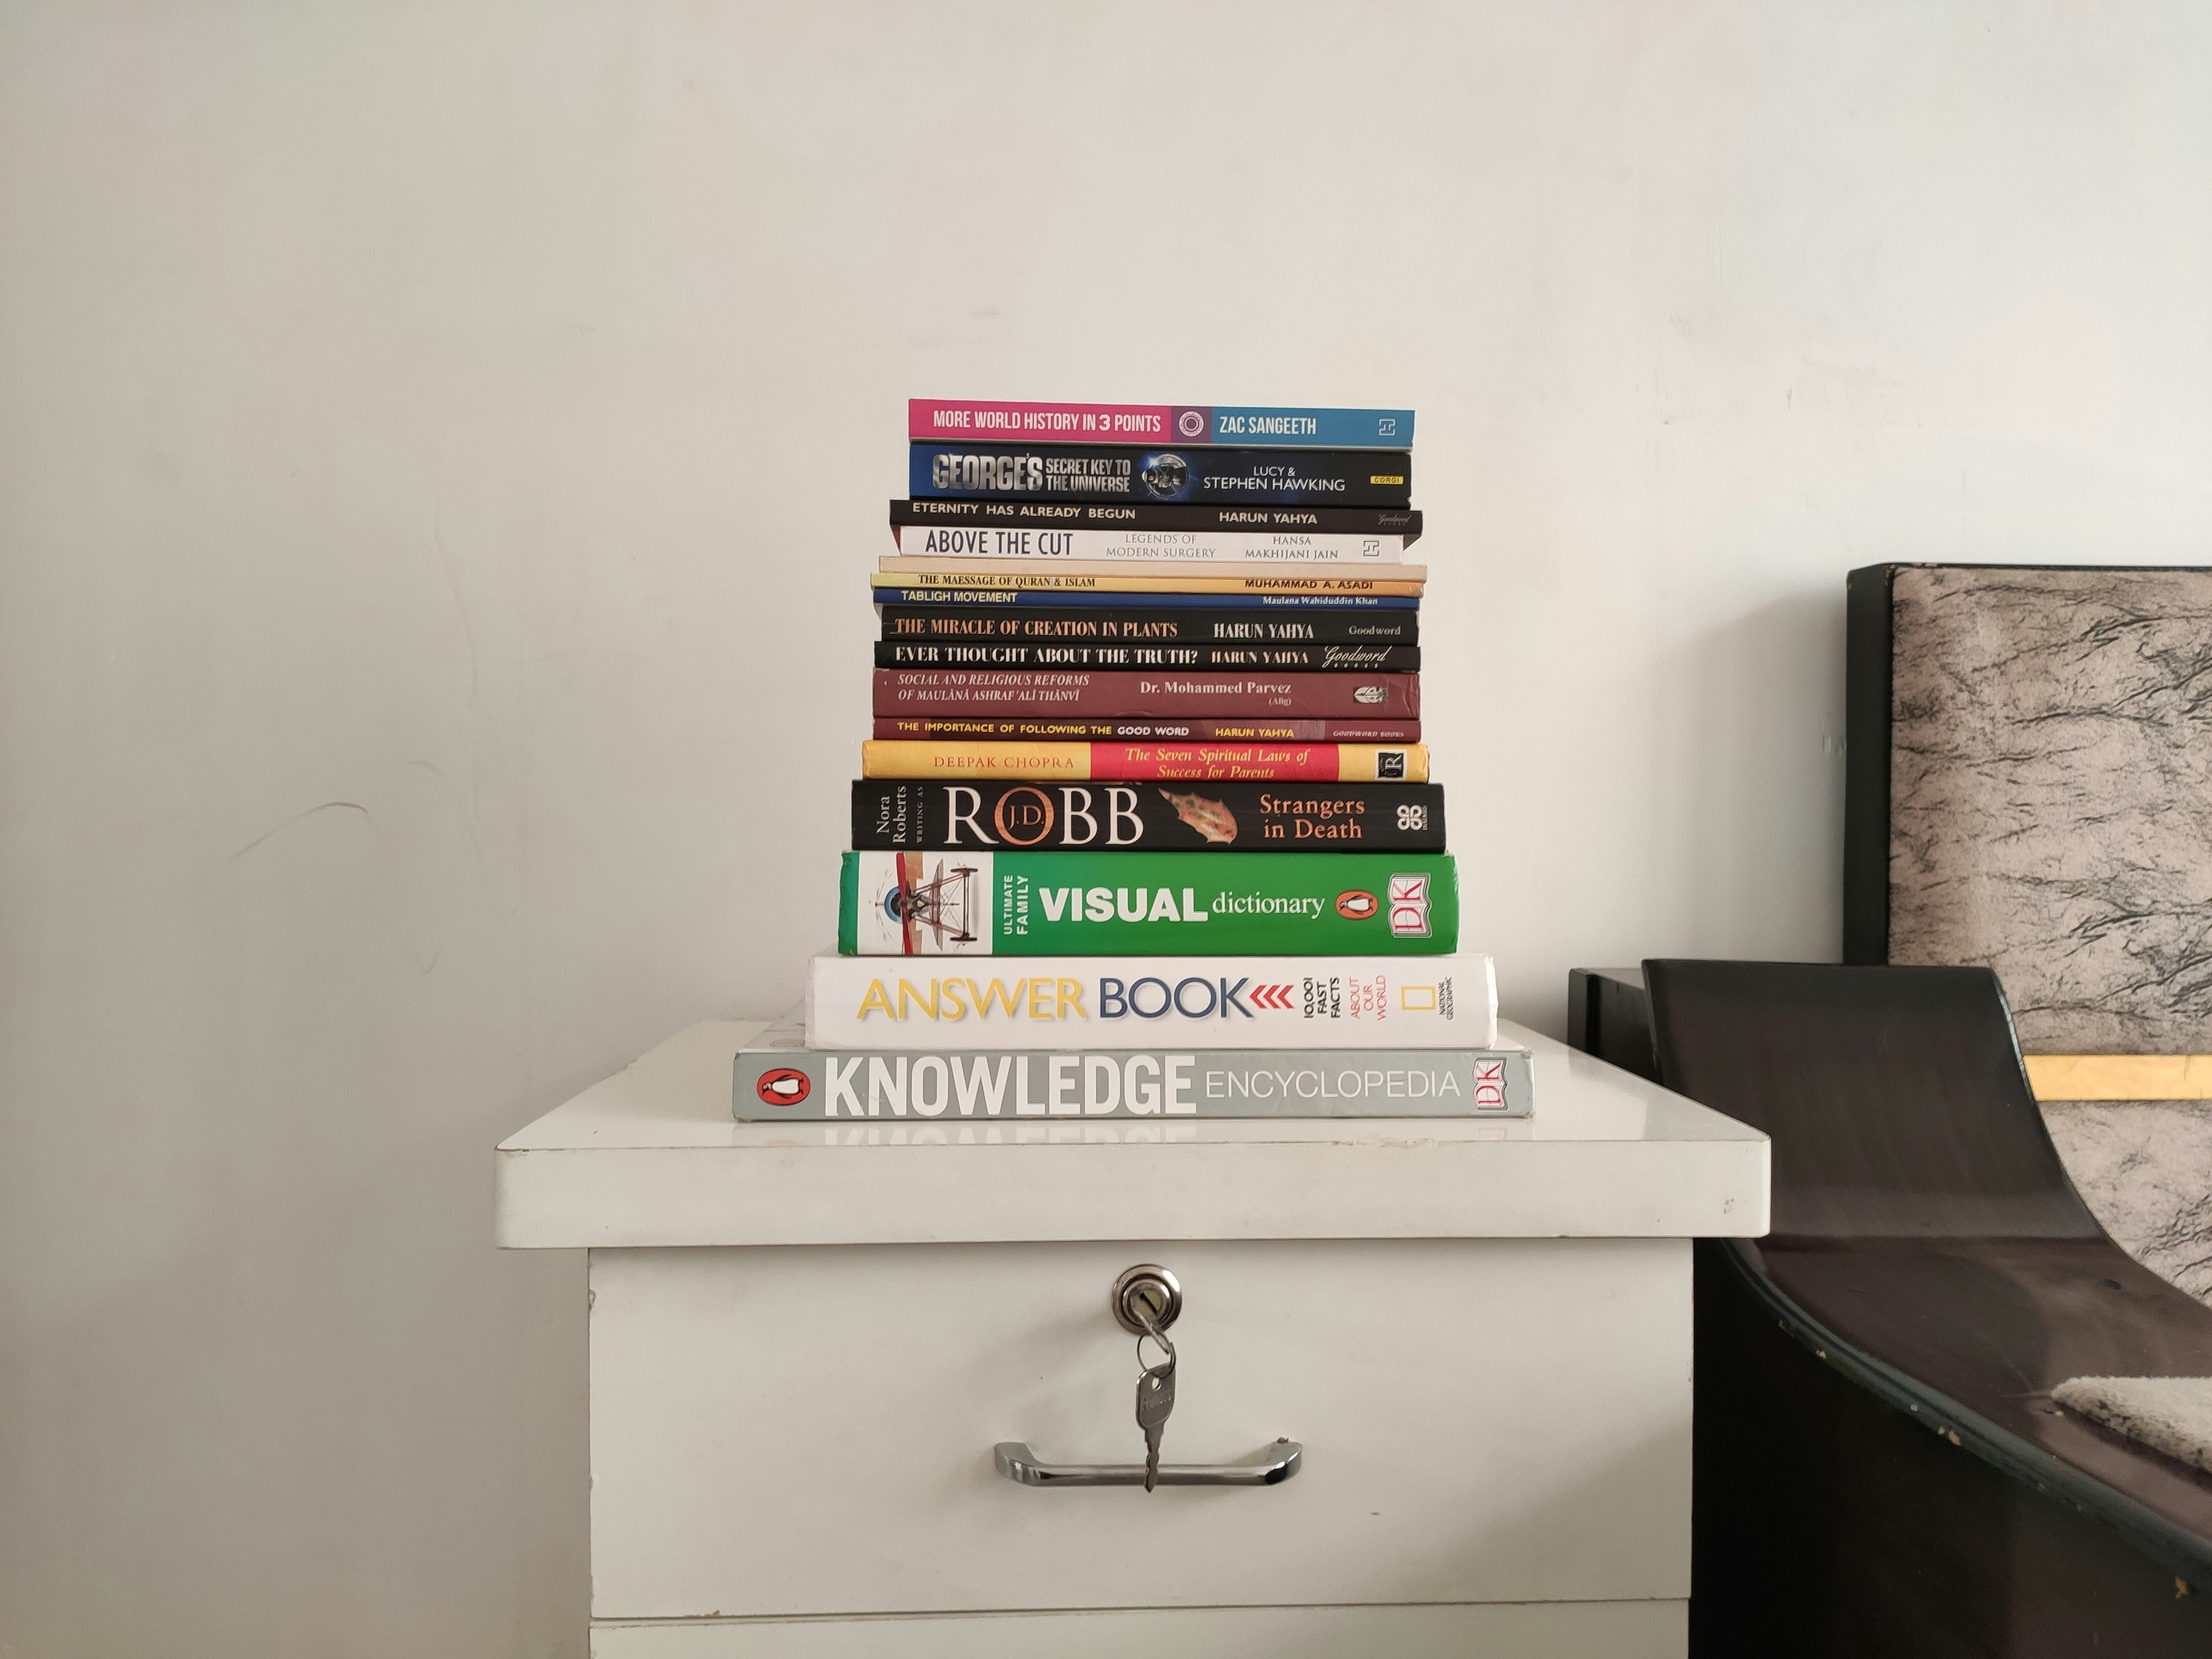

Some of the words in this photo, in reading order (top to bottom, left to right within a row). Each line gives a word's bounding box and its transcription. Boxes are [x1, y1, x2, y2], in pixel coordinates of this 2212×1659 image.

[933, 410, 971, 428] MORE
[974, 411, 1020, 429] WORLD
[1024, 412, 1079, 430] HISTORY
[1083, 414, 1096, 431] IN
[1098, 414, 1110, 431] 3
[1114, 414, 1161, 432] POINTS
[1219, 416, 1245, 434] ZAC
[1249, 417, 1317, 435] SANGEETH
[932, 452, 1042, 491] GEORGE'S
[1046, 458, 1089, 475] SECRET
[1091, 458, 1113, 475] KEY
[1115, 459, 1131, 476] TO
[1253, 466, 1285, 477] LUCY
[1287, 467, 1296, 476] &
[1046, 475, 1068, 491] THE
[1070, 476, 1130, 492] UNIVERSE
[1203, 476, 1267, 490] STEPHEN
[1272, 478, 1345, 492] HAWKING
[912, 502, 979, 515] ETERNITY
[986, 504, 1014, 516] HAS
[1019, 505, 1082, 518] ALREADY
[1088, 508, 1136, 519] BEGUN
[1219, 512, 1268, 523] HARUN
[1272, 513, 1318, 524] YAHYA
[925, 530, 988, 554] ABOVE
[995, 532, 1031, 555] THE
[1038, 533, 1073, 556] CUT
[1125, 534, 1177, 544] LEGENDS
[1182, 535, 1197, 544] OF
[1272, 536, 1311, 545] HANSA
[1106, 547, 1159, 557] MODERN
[1164, 548, 1215, 558] SURGERY
[1245, 549, 1310, 560] MAKHIJANI
[1313, 550, 1339, 560] JAIN
[918, 575, 940, 585] THE
[942, 575, 995, 585] MAESSAGE
[999, 577, 1013, 586] OF
[1015, 577, 1051, 588] QURAN
[1053, 577, 1061, 587] &
[1065, 577, 1095, 587] ISLAM
[1245, 579, 1317, 588] MUHAMMAD
[1337, 581, 1373, 589] ASADI
[901, 590, 951, 602] TABLIGH
[954, 591, 1018, 603] MOVEMENT
[1301, 596, 1353, 604] Wahiduddin
[1355, 597, 1378, 605] Khan
[895, 618, 925, 633] THE
[931, 619, 995, 634] MIRACLE
[1000, 620, 1020, 635] OF
[1024, 620, 1097, 636] CREATION
[1102, 622, 1118, 637] IN
[1123, 622, 1178, 638] PLANTS
[1213, 622, 1263, 639] HARUN
[1268, 623, 1314, 639] YAHYA
[1349, 625, 1401, 636] Goodword
[895, 646, 939, 661] EVER
[945, 646, 1029, 662] THOUGHT
[1033, 648, 1091, 663] ABOUT
[1095, 648, 1130, 664] THE
[1134, 649, 1198, 664] TRUTH?
[1212, 651, 1258, 664] HARUN
[1263, 651, 1309, 664] YAHYA
[1322, 645, 1392, 668] Goodword
[898, 674, 940, 686] SOCIAL
[941, 674, 966, 685] AND
[968, 674, 1031, 686] RELIGIOUS
[1034, 674, 1090, 686] REFORMS
[1140, 682, 1160, 694] Dr.
[1164, 682, 1242, 694] Mohammed
[1247, 682, 1291, 694] Parvez
[898, 689, 915, 701] OF
[972, 690, 1014, 701] ASHRAF
[897, 722, 919, 731] THE
[925, 723, 994, 733] IMPORTANCE
[1000, 724, 1014, 733] OF
[1020, 724, 1087, 734] FOLLOWING
[1090, 726, 1112, 734] THE
[1117, 726, 1151, 735] GOOD
[1155, 726, 1190, 736] WORD
[1215, 728, 1255, 737] HARUN
[1258, 728, 1295, 738] YAHYA
[934, 757, 996, 768] DEEPAK
[1004, 757, 1075, 768] CHOPRA
[1125, 748, 1151, 761] The
[1156, 748, 1192, 761] Seven
[1198, 748, 1251, 765] Spiritual
[1258, 749, 1291, 762] Laws
[1297, 748, 1311, 765] of
[1157, 765, 1202, 778] Success
[1207, 765, 1224, 779] for
[1229, 765, 1275, 779] Parents
[916, 786, 924, 797] AS
[893, 785, 906, 843] Roberts
[1260, 794, 1365, 816] Strangers
[877, 796, 890, 834] Nora
[942, 786, 1144, 846] ROBB
[1008, 804, 1044, 830] J.D.
[1265, 818, 1285, 838] in
[1295, 818, 1363, 838] Death
[1004, 874, 1013, 935] ULTIMATE
[1017, 875, 1028, 935] FAMILY
[1039, 887, 1208, 922] VISUAL
[1212, 891, 1325, 919] dictionary
[1392, 880, 1423, 930] DK
[856, 978, 1087, 1020] ANSWER
[1099, 977, 1254, 1019] BOOK
[1317, 981, 1327, 1014] FAST
[1330, 977, 1340, 1018] FACTS
[1349, 977, 1359, 1019] ABOUT
[1364, 984, 1373, 1011] OUR
[1376, 974, 1387, 1021] WORLD
[825, 1055, 1196, 1117] KNOWLEDGE
[1207, 1070, 1460, 1098] ENCYCLOPEDIA
[1475, 1062, 1501, 1105] DK
